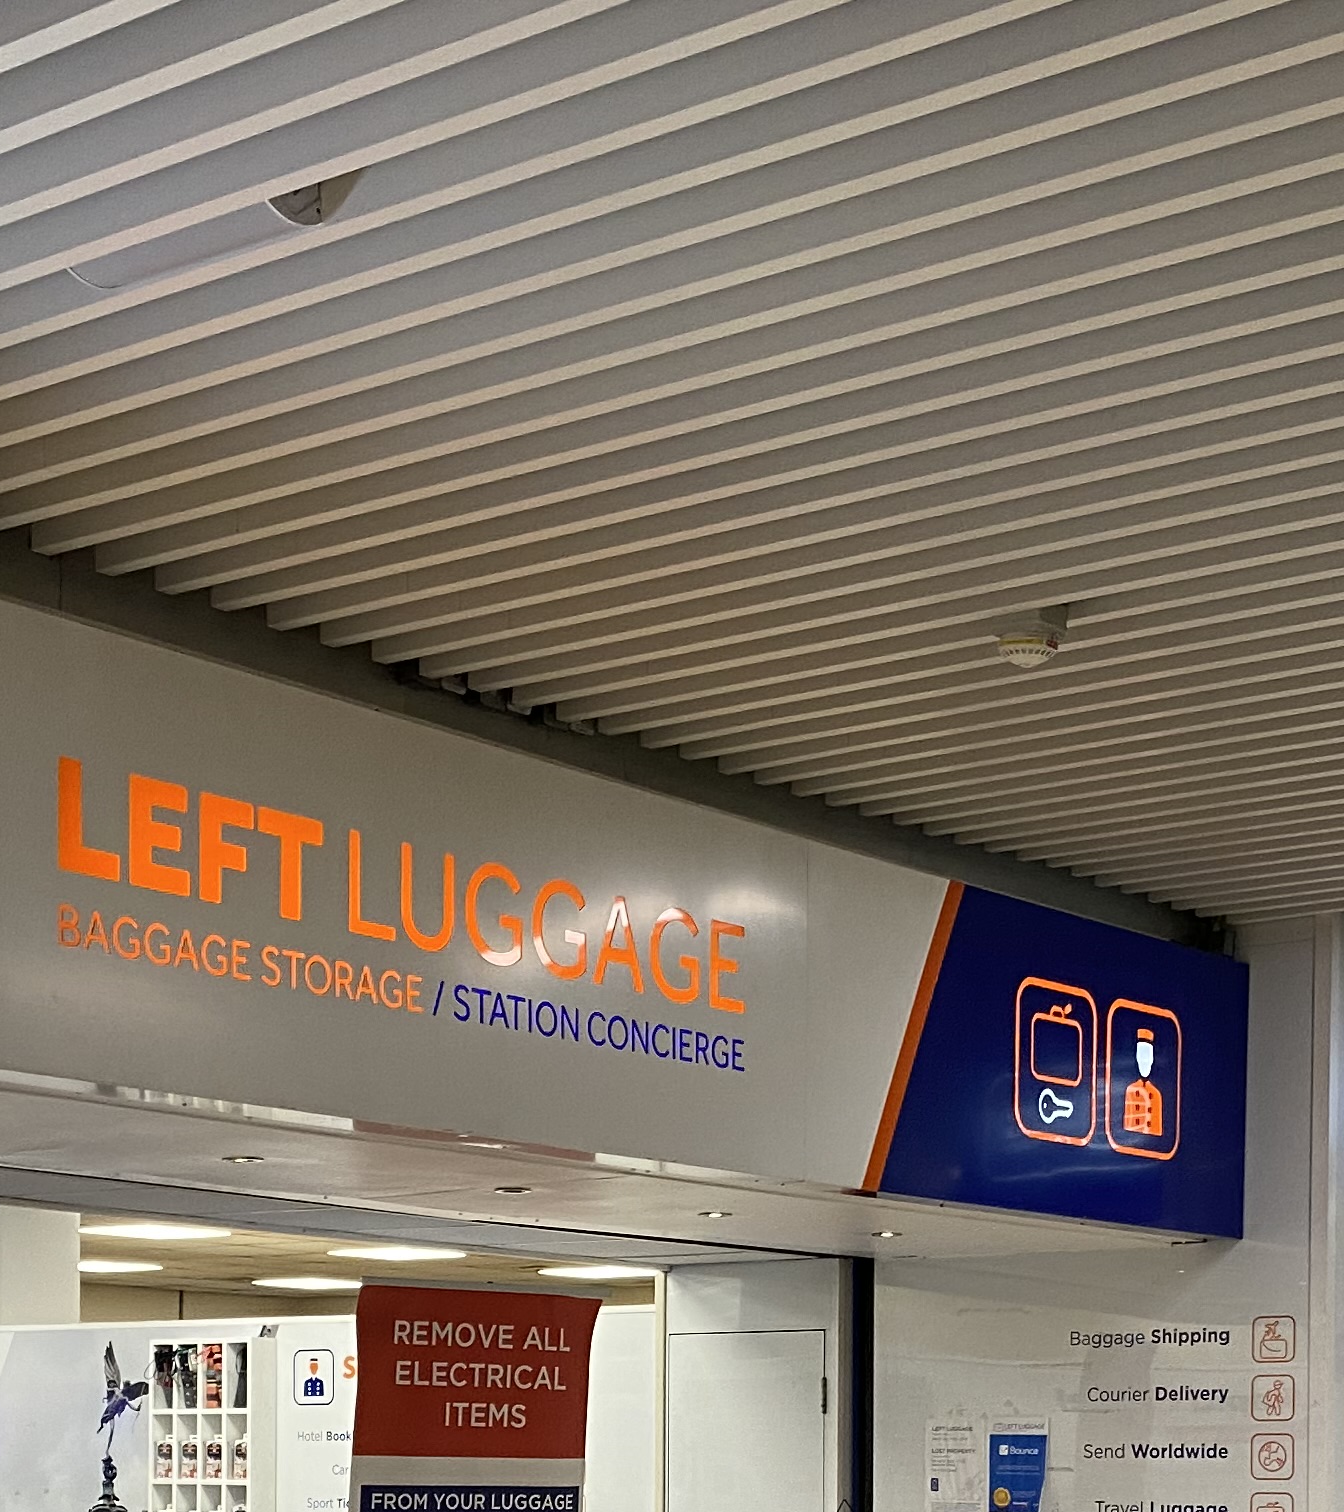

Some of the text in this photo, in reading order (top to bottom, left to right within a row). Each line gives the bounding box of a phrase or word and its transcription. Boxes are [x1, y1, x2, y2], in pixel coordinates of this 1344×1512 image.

[57, 756, 746, 1014] LEFT LUGGAGE
[57, 903, 746, 1072] BAGGAGE STORAGE / STATION CONCIERGE
[393, 1320, 570, 1352] REMOVE ALL
[1069, 1328, 1230, 1348] Baggage Shipping
[395, 1360, 567, 1390] ELECTRICAL
[1087, 1386, 1228, 1404] Courier Delivery
[445, 1402, 526, 1428] ITEMS
[298, 1431, 323, 1442] Hotel
[1010, 1446, 1039, 1456] Bounce
[1083, 1444, 1228, 1459] Send Worldwide
[307, 1497, 334, 1511] Sport
[371, 1493, 573, 1510] FROM YOUR LUGGAGE
